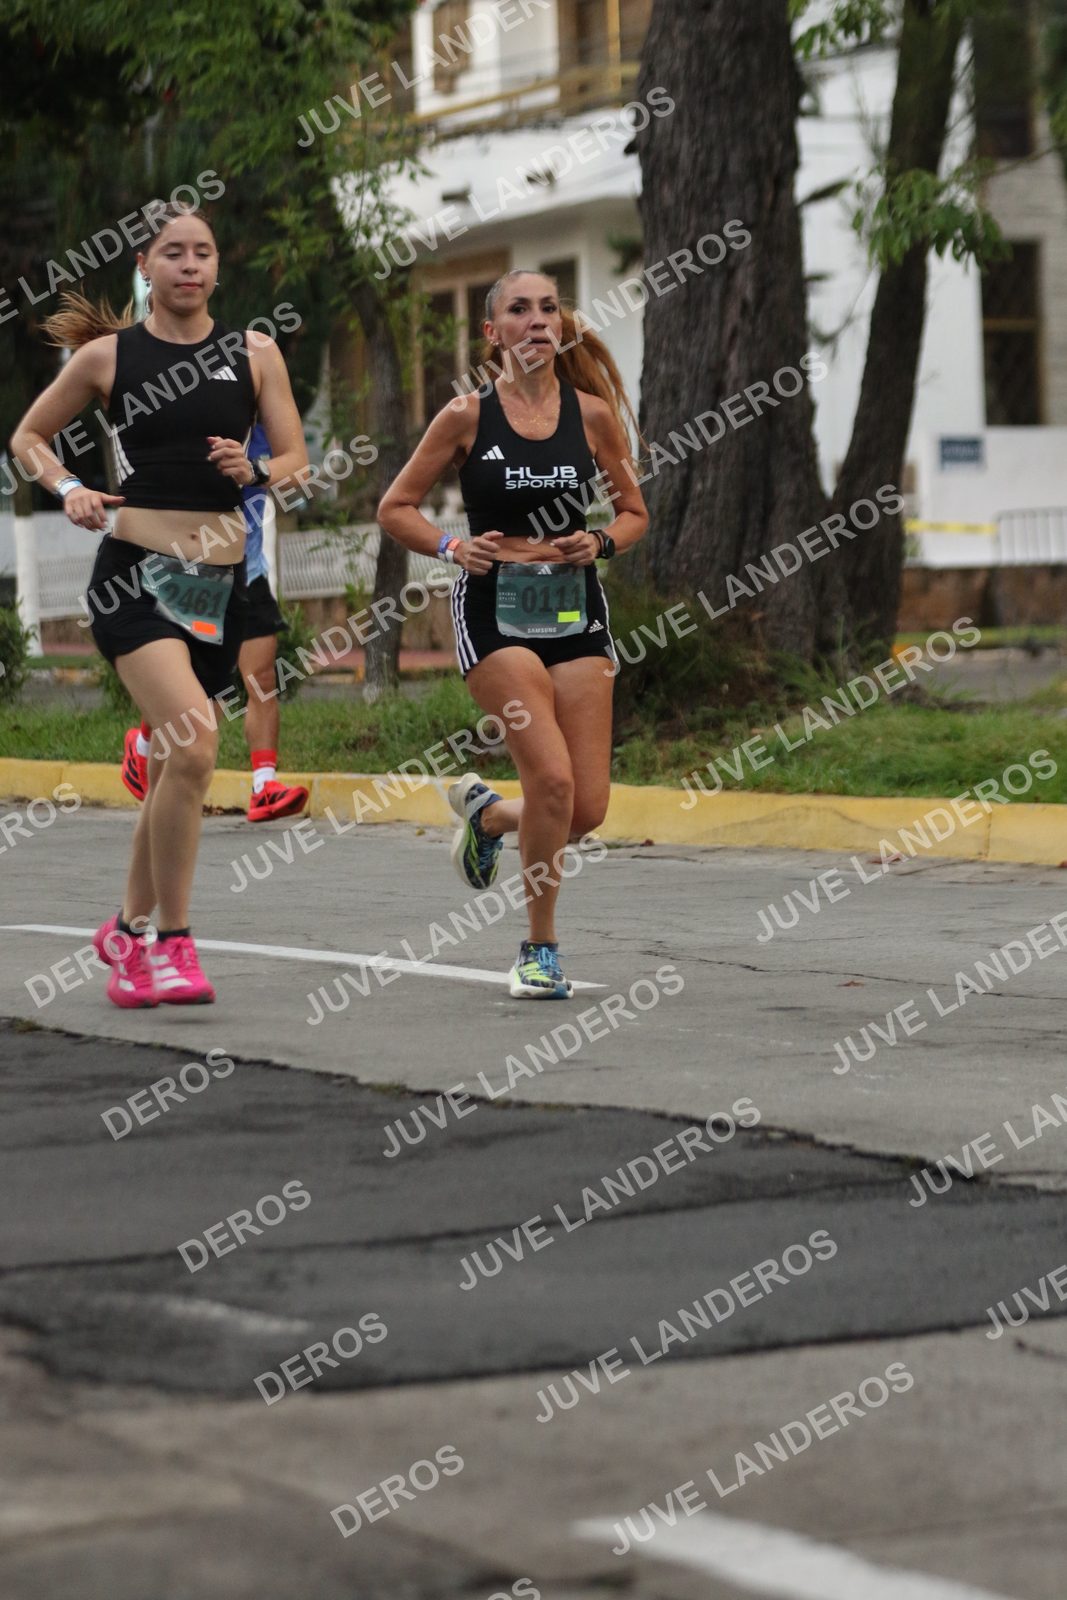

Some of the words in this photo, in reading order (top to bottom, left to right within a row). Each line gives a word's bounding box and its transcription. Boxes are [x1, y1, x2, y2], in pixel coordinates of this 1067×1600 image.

[505, 466, 577, 479] HUB
[505, 479, 579, 489] SPORTS
[522, 584, 582, 613] 0111
